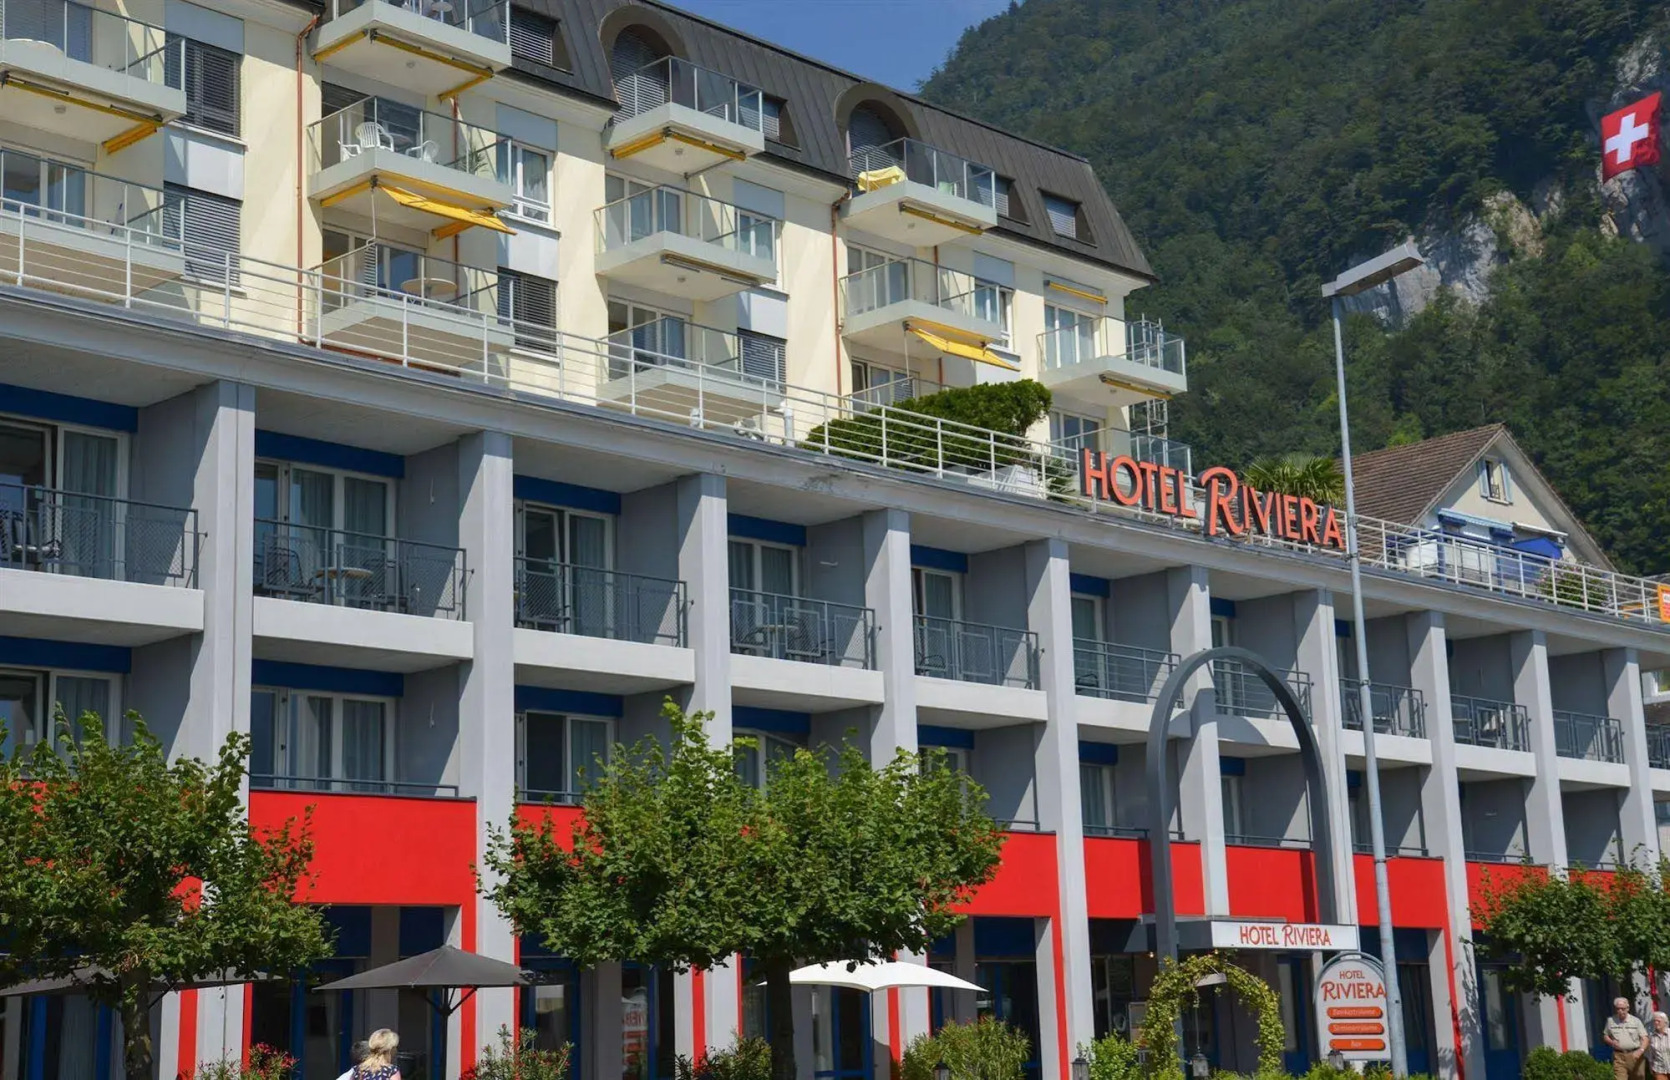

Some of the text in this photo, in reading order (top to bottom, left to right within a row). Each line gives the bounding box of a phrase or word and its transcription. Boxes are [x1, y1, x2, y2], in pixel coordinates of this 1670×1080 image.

[1080, 448, 1344, 549] HOTEL RIVIERA
[1240, 924, 1332, 947] HOTEL RIVIERA
[1339, 970, 1365, 979] HOTEL
[1321, 981, 1388, 1002] RIVIERA
